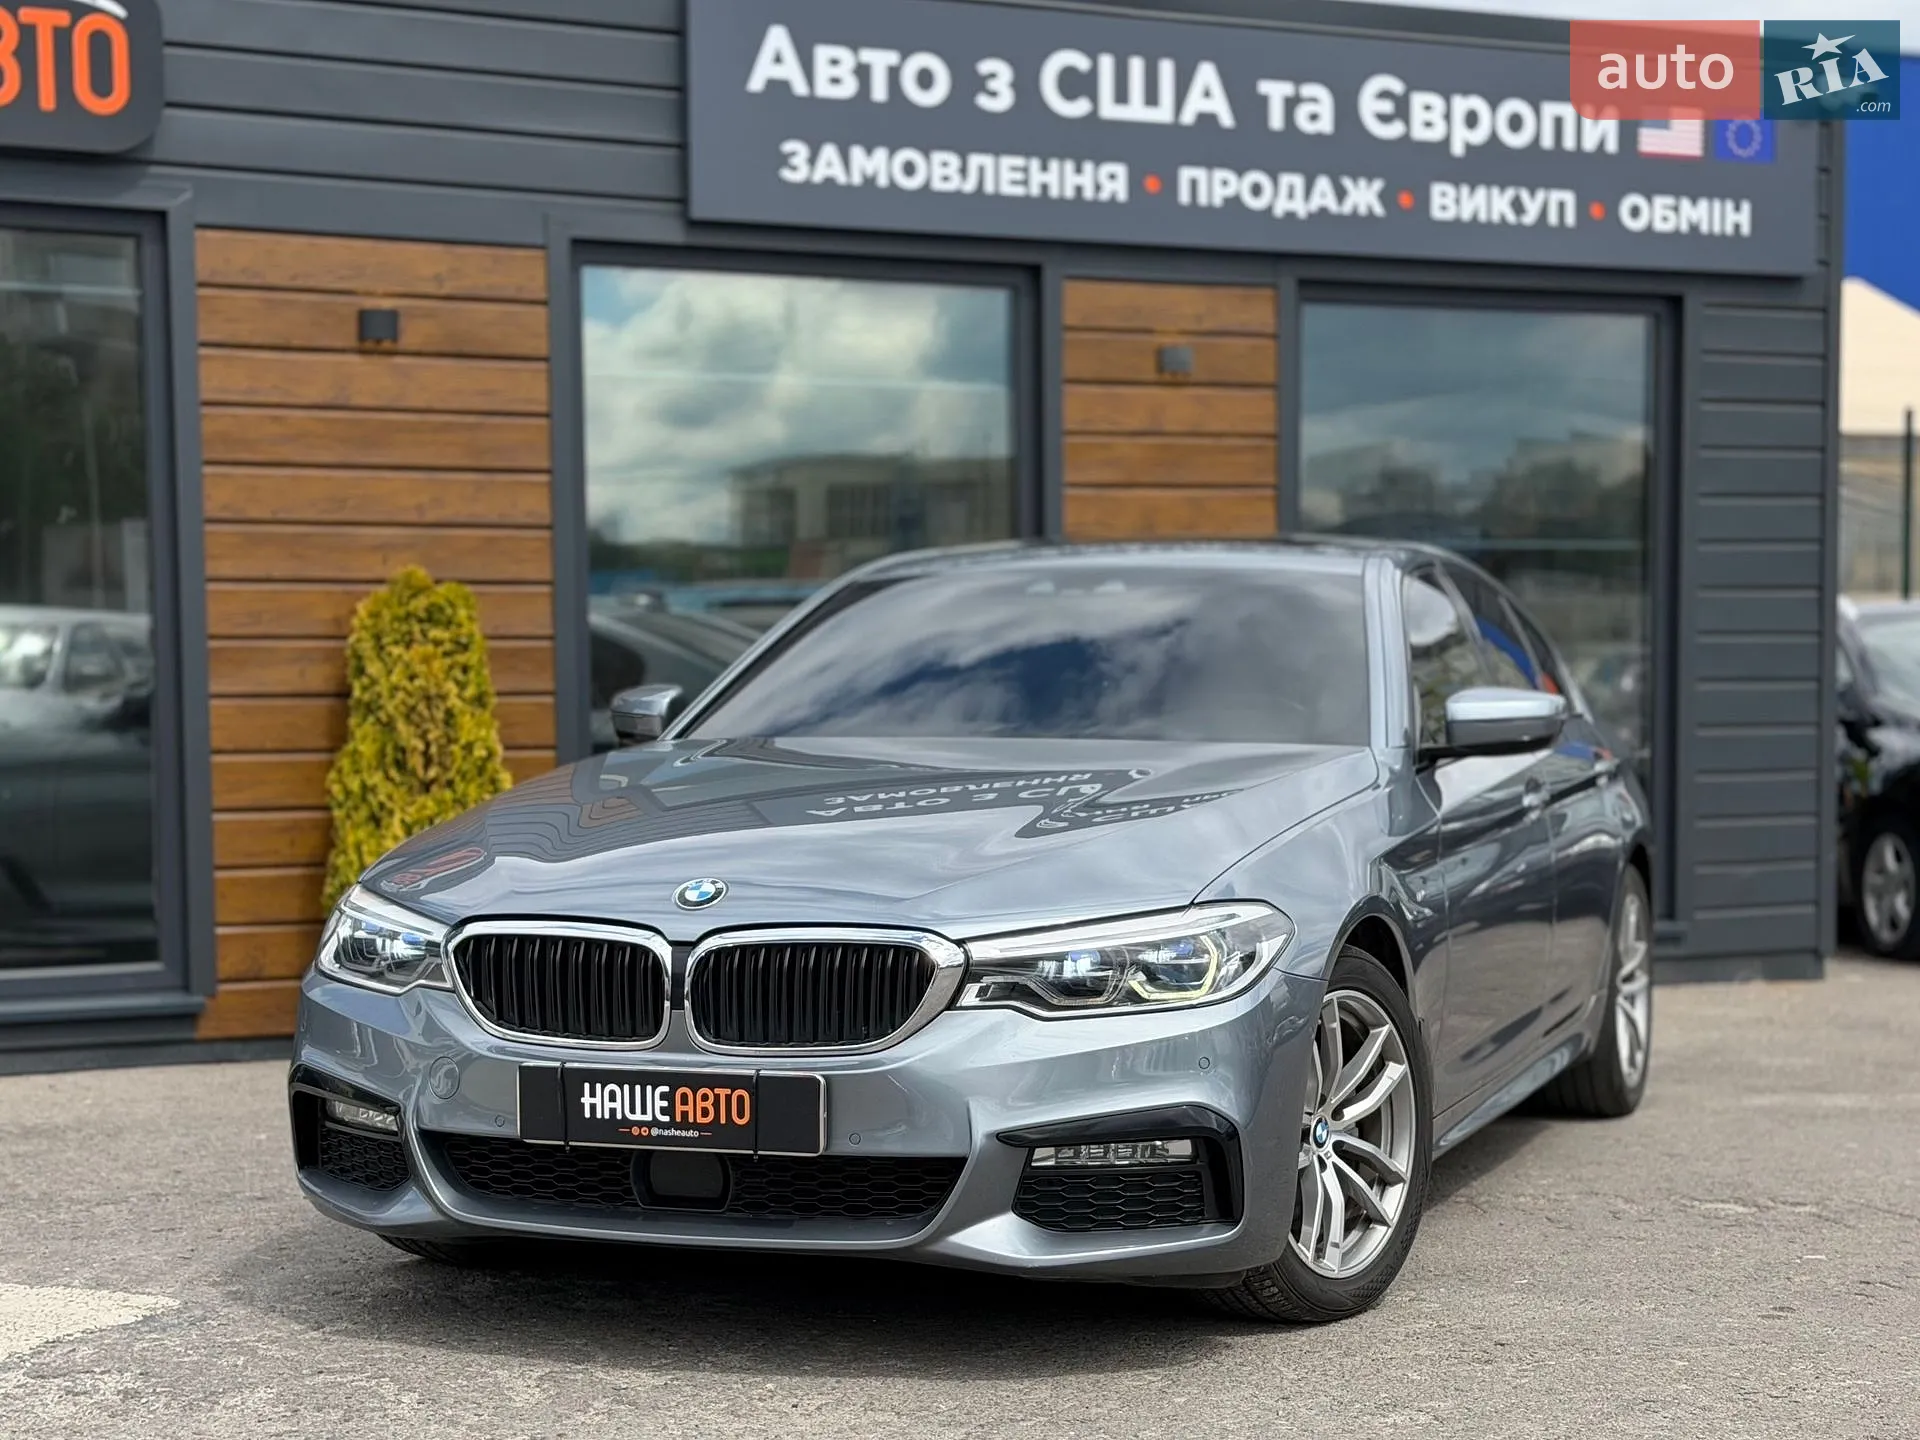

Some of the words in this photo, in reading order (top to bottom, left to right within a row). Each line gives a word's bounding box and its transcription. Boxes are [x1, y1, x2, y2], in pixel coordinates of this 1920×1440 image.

[746, 24, 952, 108] Авто
[974, 58, 1016, 112] з
[1039, 49, 1236, 129] США
[1256, 79, 1335, 135] та
[1357, 73, 1620, 157] Європи
[778, 139, 1129, 202] ЗАМОВЛЕННЯ
[1177, 165, 1387, 220] ПРОДАЖ
[1429, 181, 1577, 228] ВИКУП
[1617, 192, 1752, 237] ОБМІН
[580, 1082, 670, 1122] НАШЕ
[674, 1086, 750, 1126] АВТО
[650, 1126, 699, 1138] @nasheauto
